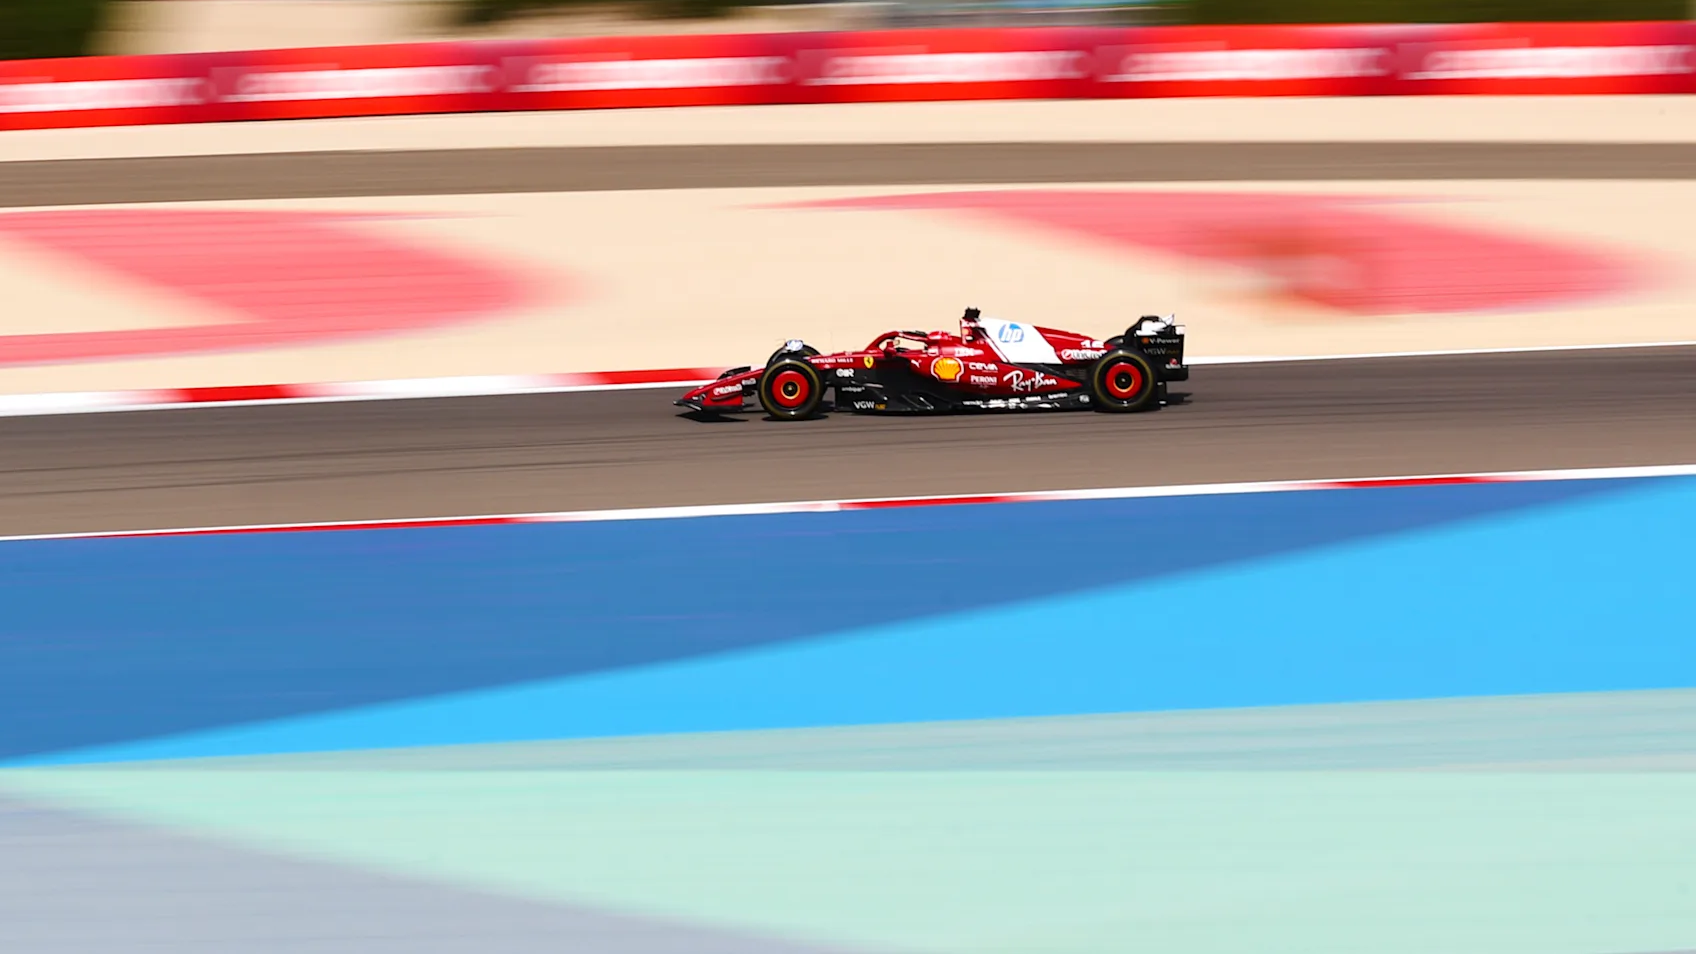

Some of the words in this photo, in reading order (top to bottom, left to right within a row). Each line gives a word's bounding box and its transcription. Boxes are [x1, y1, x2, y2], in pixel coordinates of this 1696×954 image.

[999, 323, 1024, 343] hp
[970, 374, 997, 384] PERONI
[853, 400, 875, 410] VGW
